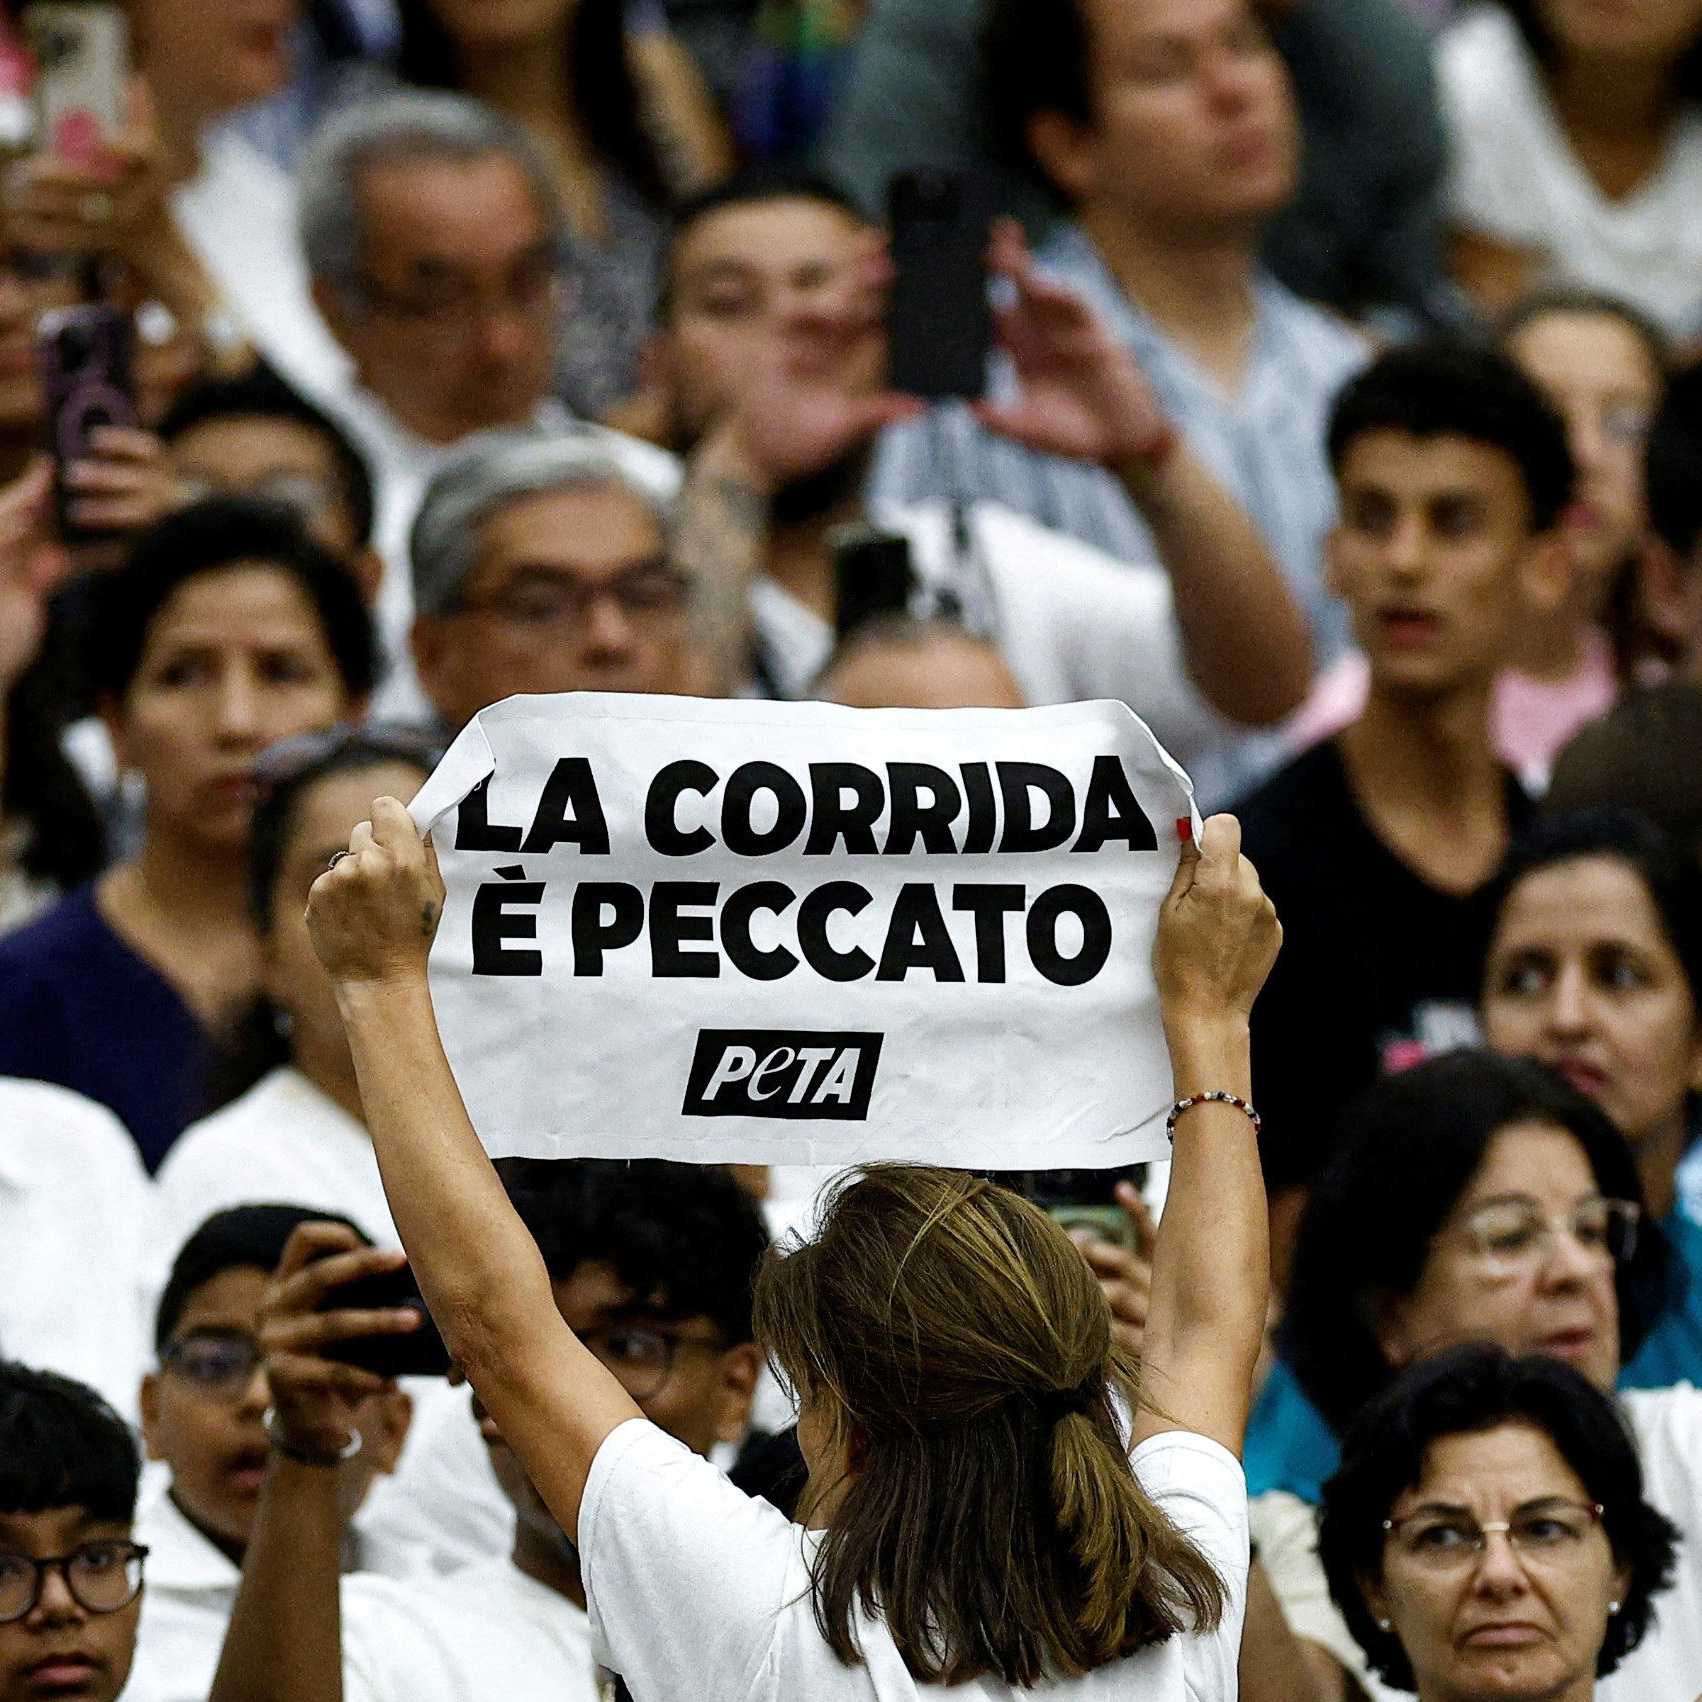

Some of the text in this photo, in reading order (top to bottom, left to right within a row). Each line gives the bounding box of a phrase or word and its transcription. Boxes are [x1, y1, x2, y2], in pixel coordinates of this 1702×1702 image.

[454, 755, 1159, 858] LA CORRIDA
[471, 864, 1113, 987] È PECCATO
